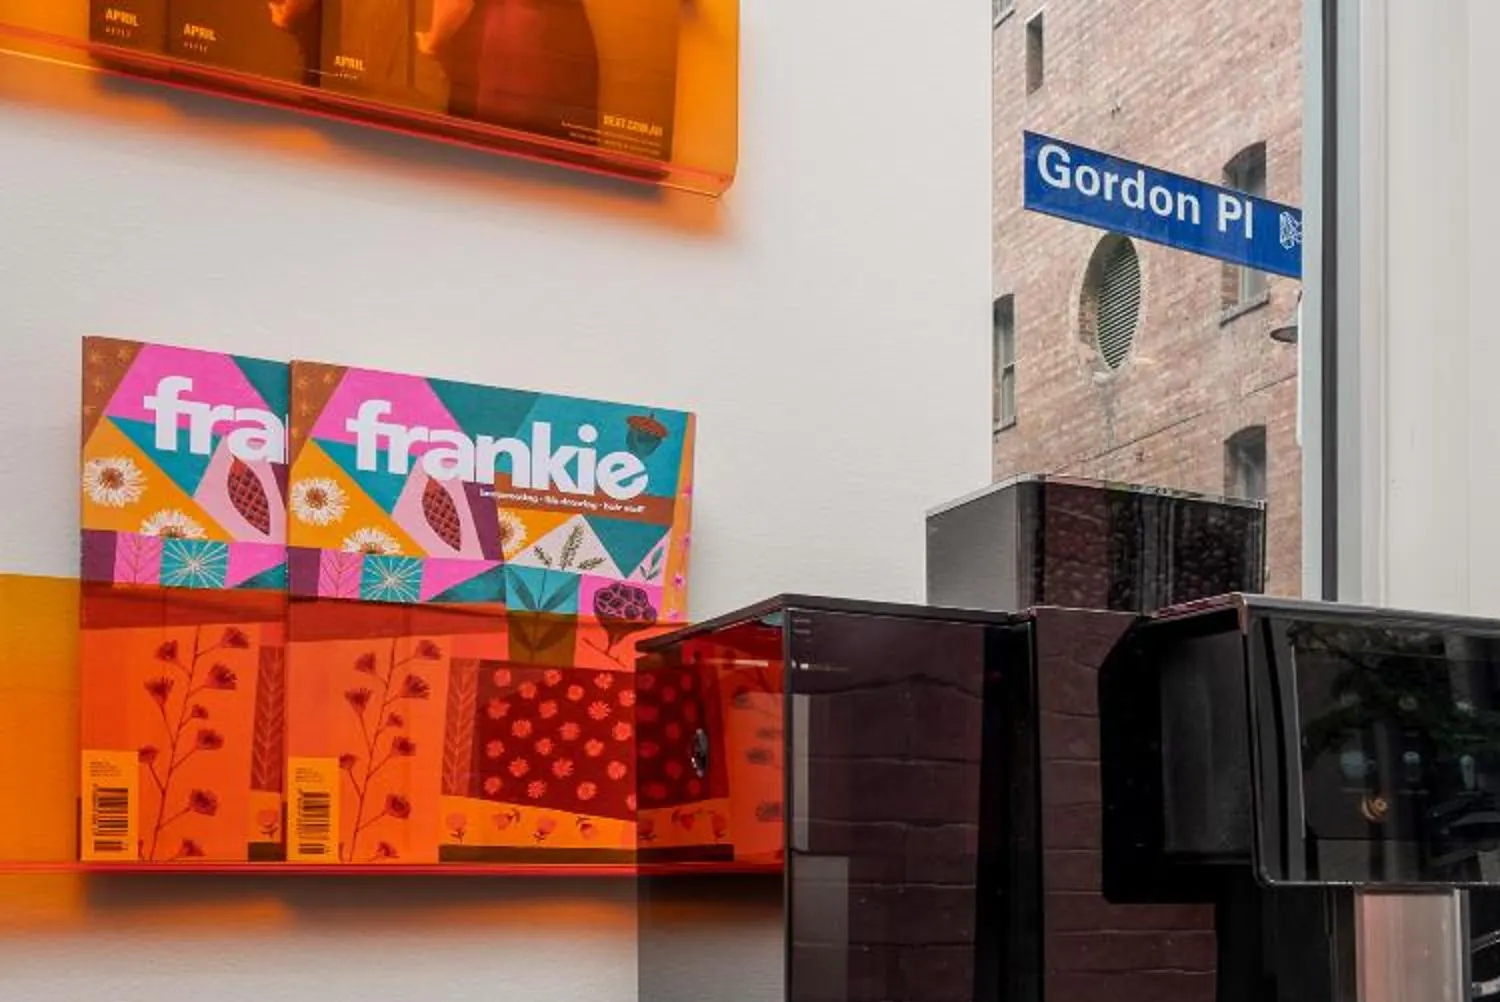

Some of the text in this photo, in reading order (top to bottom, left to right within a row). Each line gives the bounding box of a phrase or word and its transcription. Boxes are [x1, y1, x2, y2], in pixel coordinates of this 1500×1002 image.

[1037, 144, 1254, 240] Gordon Pl
[143, 375, 288, 465] fra
[345, 400, 650, 501] frankie
